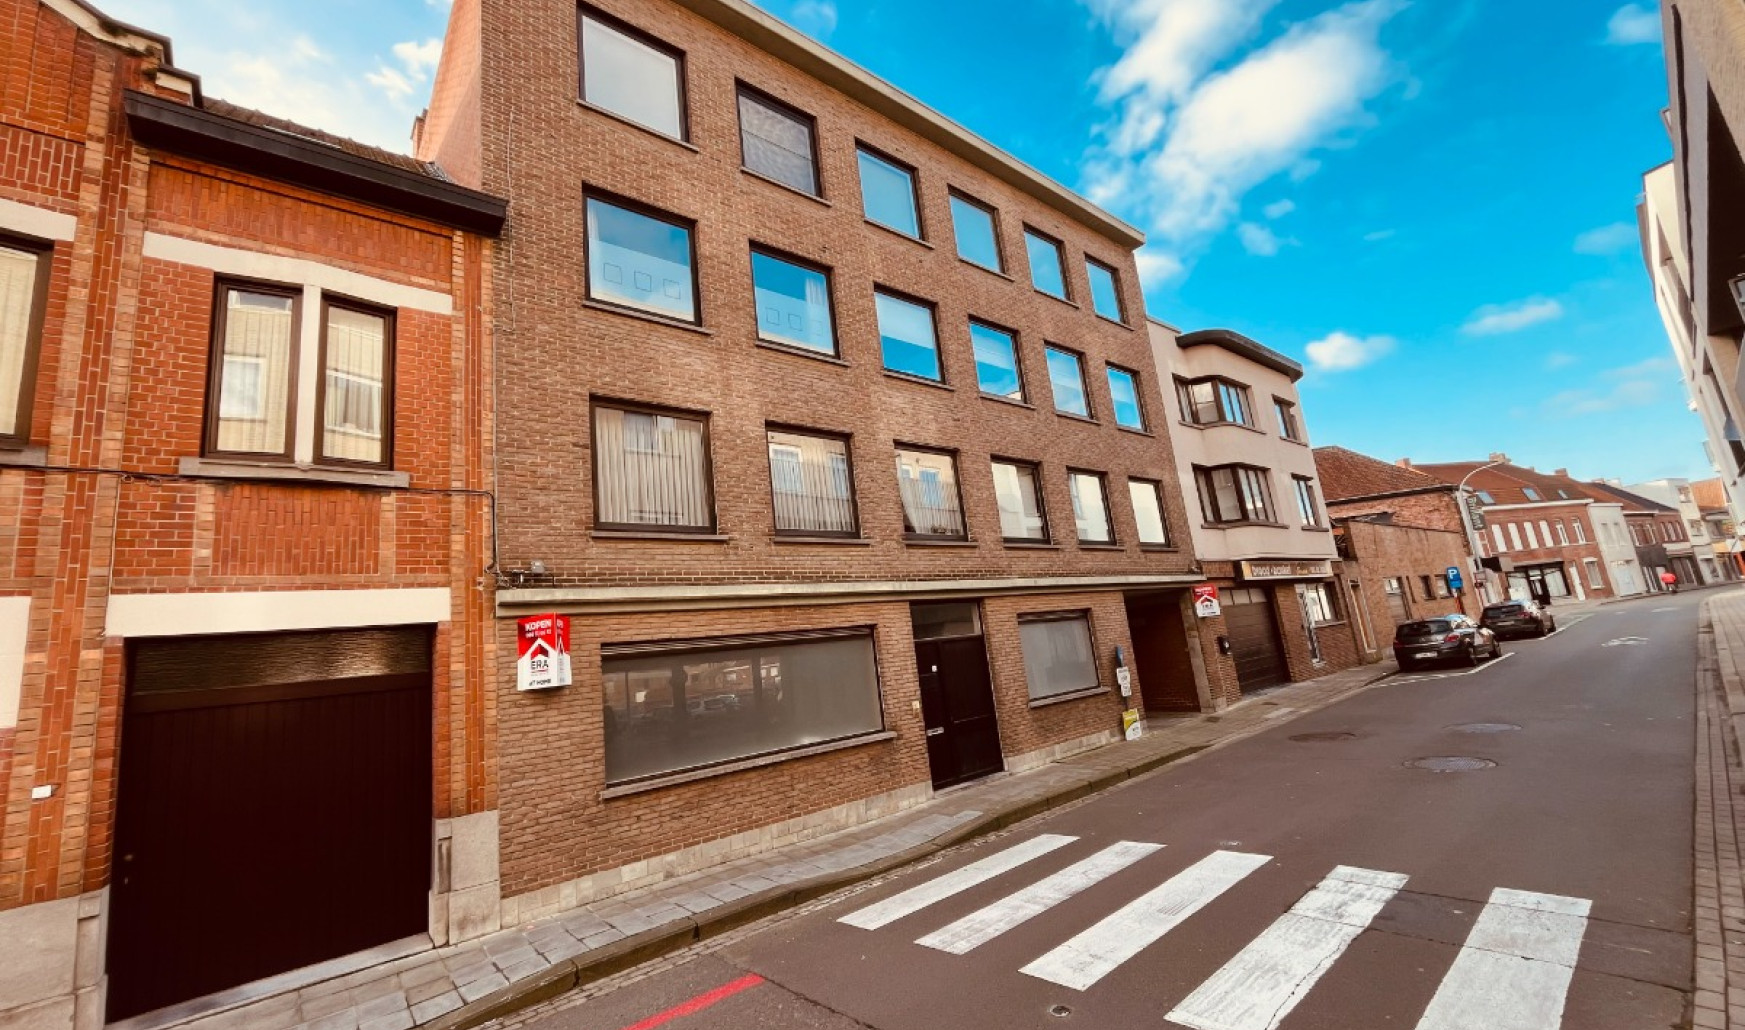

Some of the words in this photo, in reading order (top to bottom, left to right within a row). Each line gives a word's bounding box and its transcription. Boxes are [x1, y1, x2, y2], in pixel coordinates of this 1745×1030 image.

[1448, 569, 1458, 579] P
[525, 619, 551, 631] KOPEN
[531, 660, 548, 670] ERA
